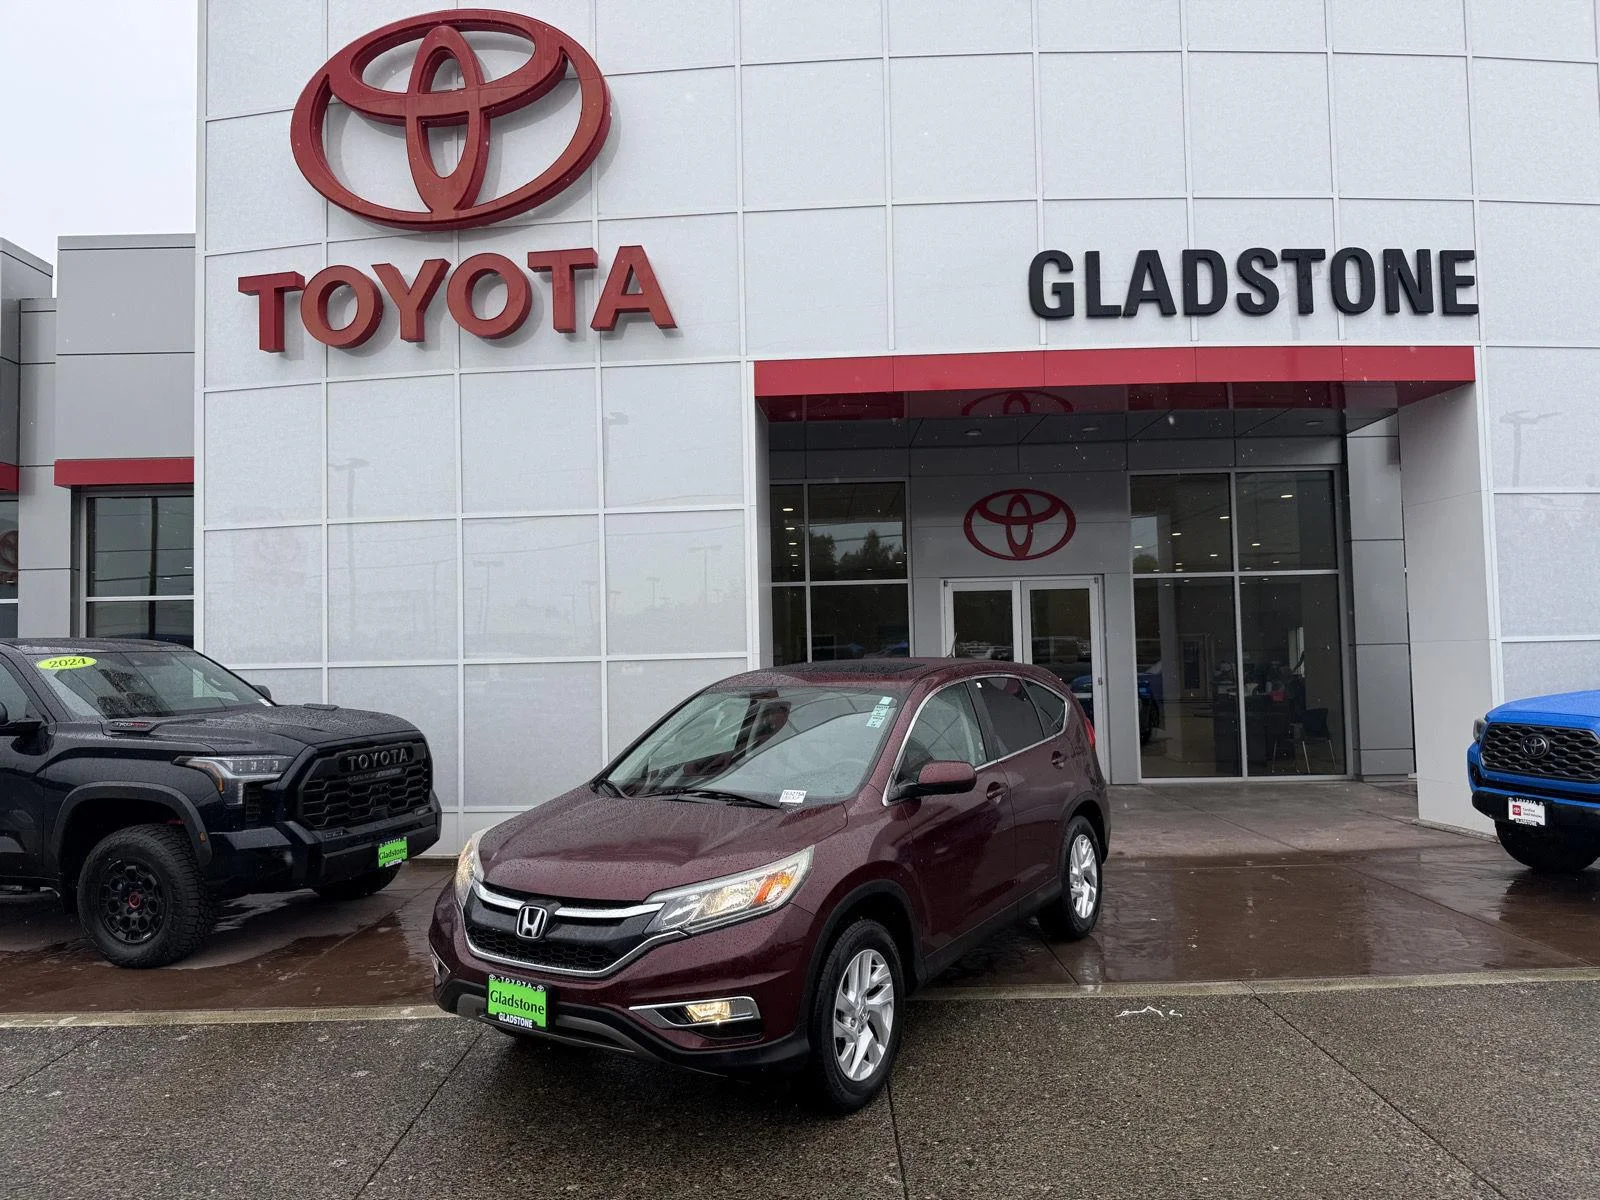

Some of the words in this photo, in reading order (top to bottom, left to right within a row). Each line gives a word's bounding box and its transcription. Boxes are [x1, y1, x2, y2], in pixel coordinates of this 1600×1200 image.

[1028, 247, 1479, 318] GLADSTONE
[238, 245, 677, 352] TOYOTA
[49, 657, 87, 668] 2024
[347, 748, 408, 771] TOYOTA
[500, 976, 532, 989] TOYOTA
[490, 989, 545, 1015] Gladstone
[498, 1012, 533, 1028] GLADSTONE
